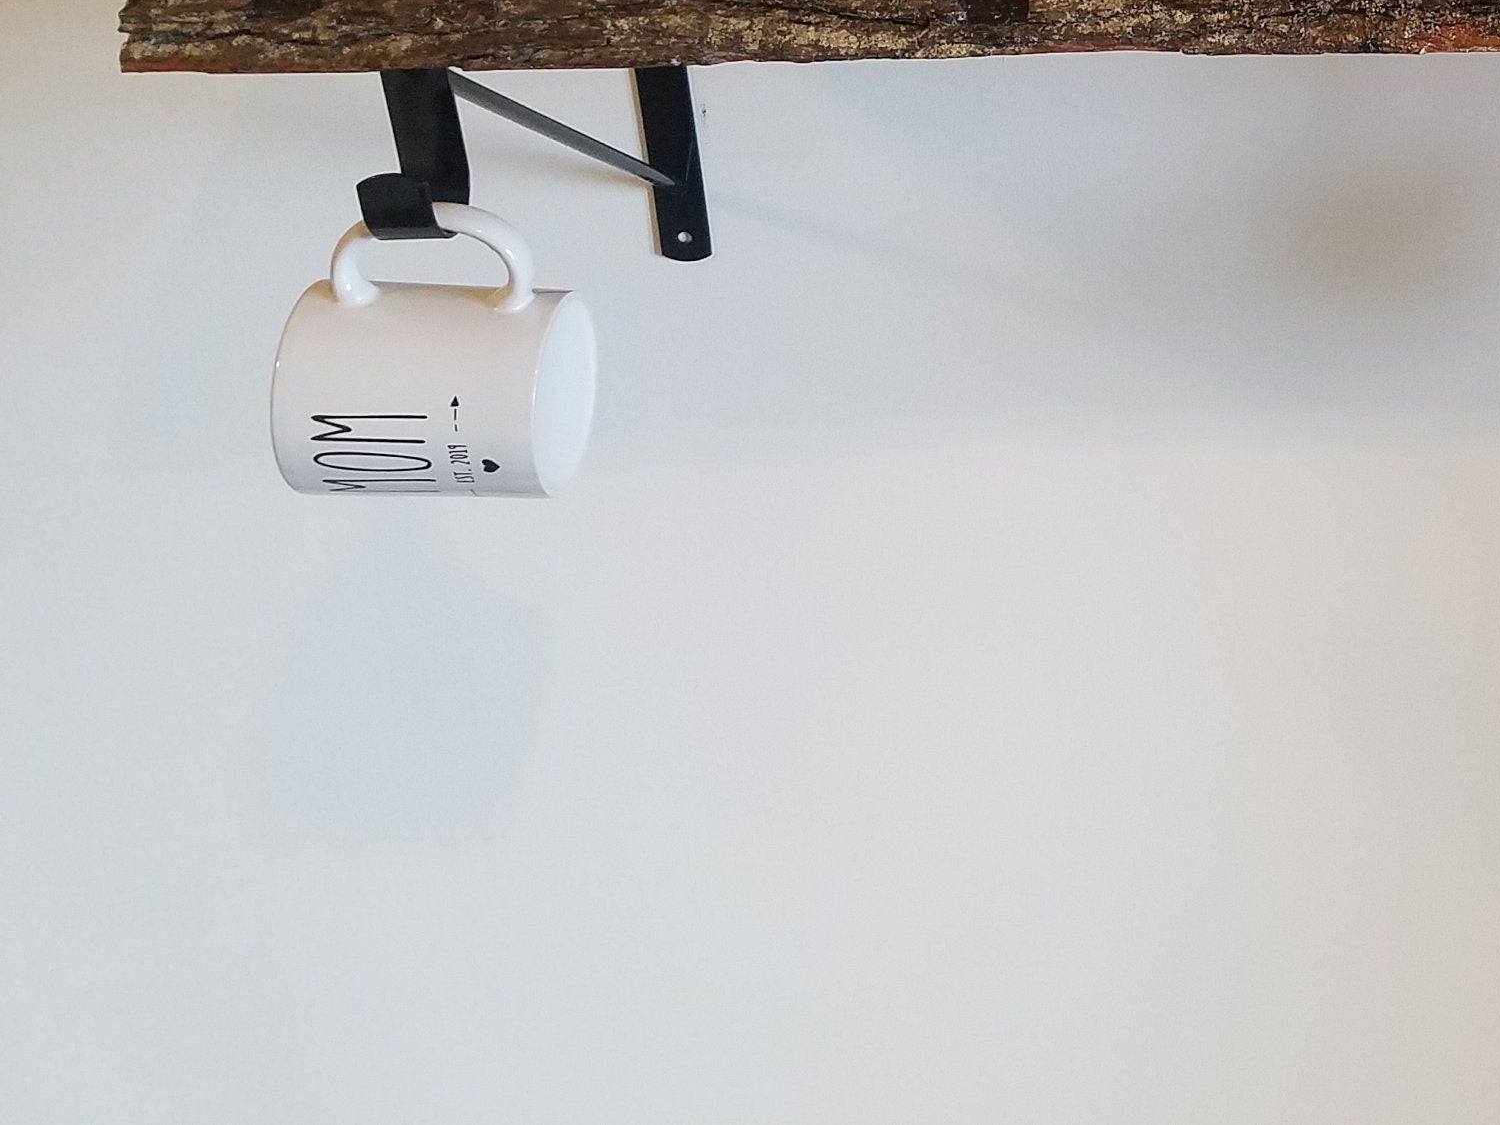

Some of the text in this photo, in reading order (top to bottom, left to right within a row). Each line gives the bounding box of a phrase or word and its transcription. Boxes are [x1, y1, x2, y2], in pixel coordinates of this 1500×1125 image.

[311, 414, 441, 493] MOM
[447, 444, 475, 483] EST. 2019
